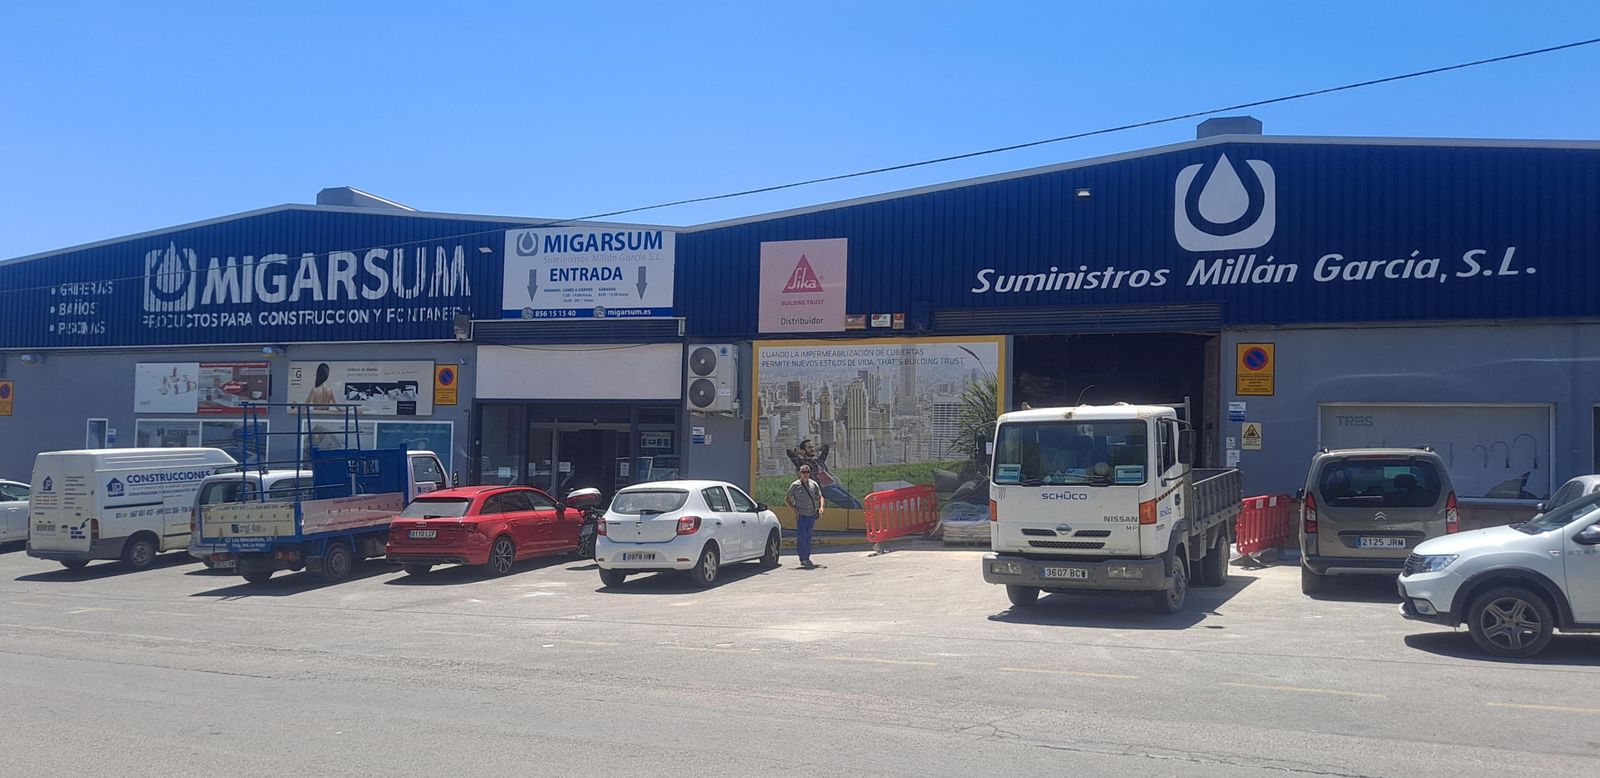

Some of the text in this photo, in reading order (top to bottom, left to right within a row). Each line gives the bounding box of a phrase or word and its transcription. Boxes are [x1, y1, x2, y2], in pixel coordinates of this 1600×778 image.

[544, 230, 663, 253] MIGARSUM
[201, 245, 471, 305] MIGARSUM
[550, 266, 623, 282] ENTRADA
[971, 246, 1537, 294] Suministros Millán García, S.L.
[788, 267, 817, 289] Sika
[220, 312, 253, 327] PARA
[258, 309, 369, 326] CONSTRUCCION
[373, 308, 382, 323] Y
[607, 308, 652, 317] migarsum.es
[780, 317, 824, 325] Distribuidor
[887, 348, 924, 356] CUBIERTAS
[1336, 416, 1374, 427] TRES
[126, 470, 211, 483] CONSTRUCCIONES
[1041, 491, 1087, 500] SCHÜCO
[1362, 538, 1404, 547] 2125 JRM
[1046, 568, 1067, 576] 3607
